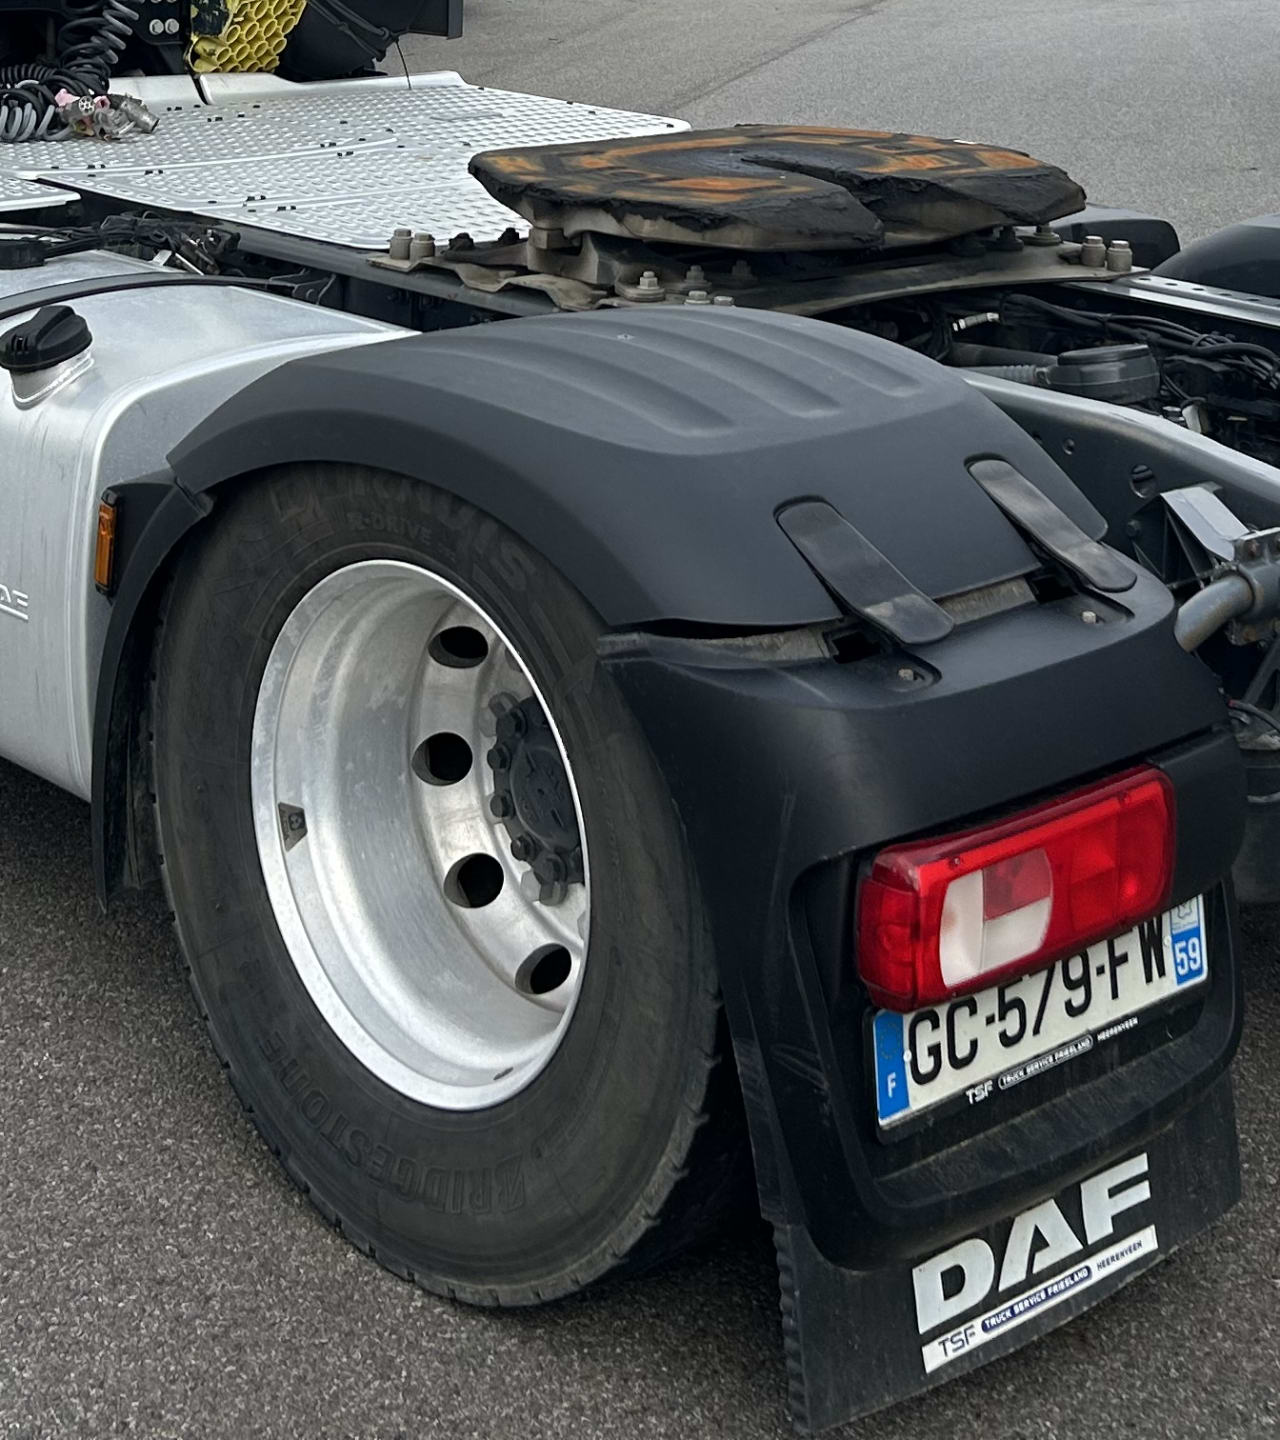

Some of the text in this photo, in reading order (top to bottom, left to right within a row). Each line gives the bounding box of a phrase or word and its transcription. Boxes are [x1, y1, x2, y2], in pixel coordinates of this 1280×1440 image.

[886, 914, 1202, 1098] F GC-579-FW 59
[965, 1080, 994, 1104] TSF
[912, 1152, 1152, 1335] DAF
[937, 1240, 1143, 1358] TSF TRUCK SERVICE FRIESLAND HEERENVEEN
